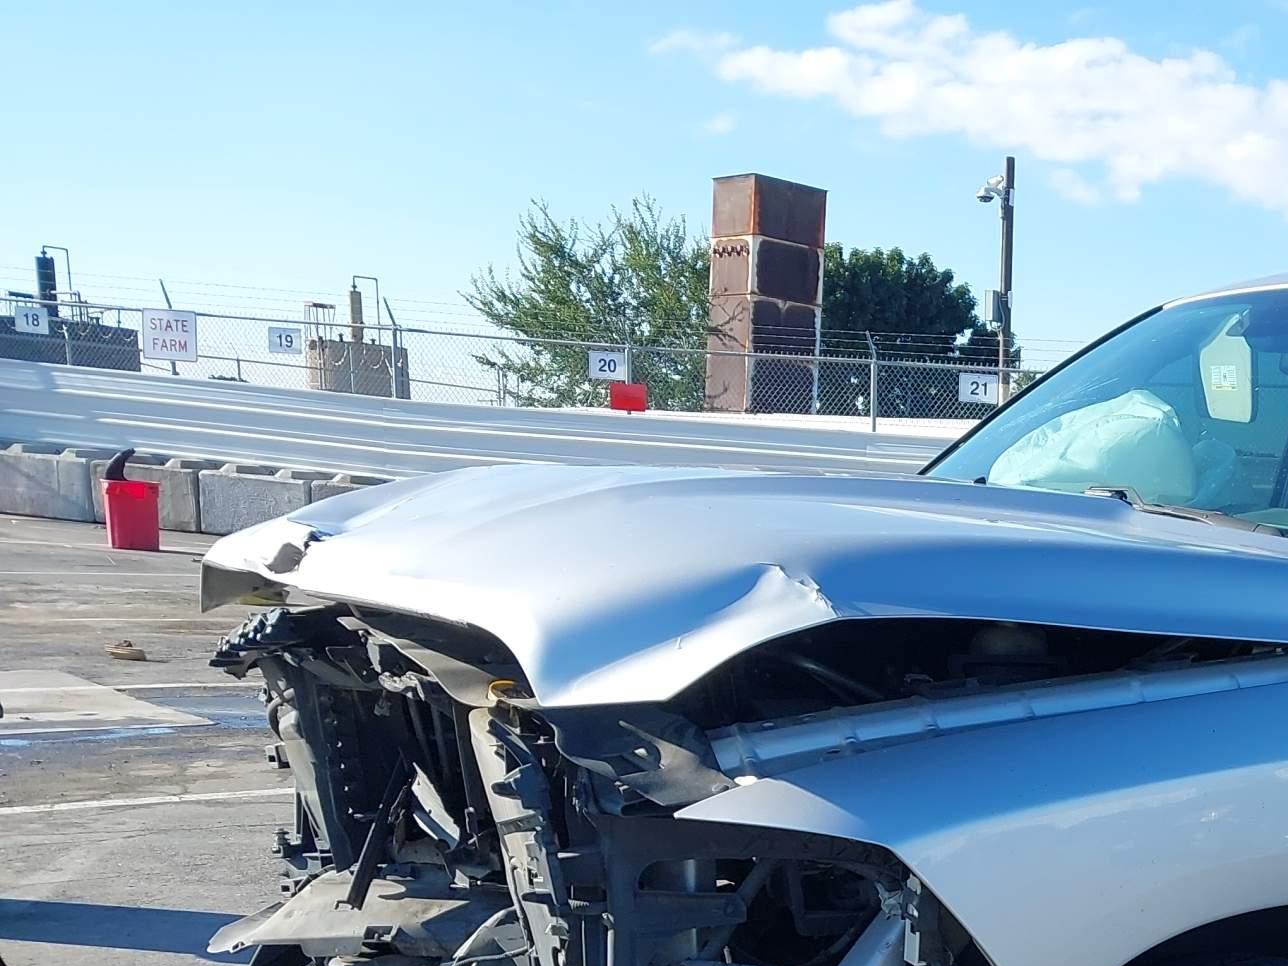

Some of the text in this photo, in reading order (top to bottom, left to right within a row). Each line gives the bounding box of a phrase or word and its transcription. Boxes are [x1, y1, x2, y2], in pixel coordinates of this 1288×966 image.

[23, 312, 40, 327] 18
[150, 317, 189, 333] STATE
[152, 337, 188, 353] FARM
[276, 333, 294, 348] 19
[598, 358, 617, 373] 20
[970, 380, 988, 397] 21
